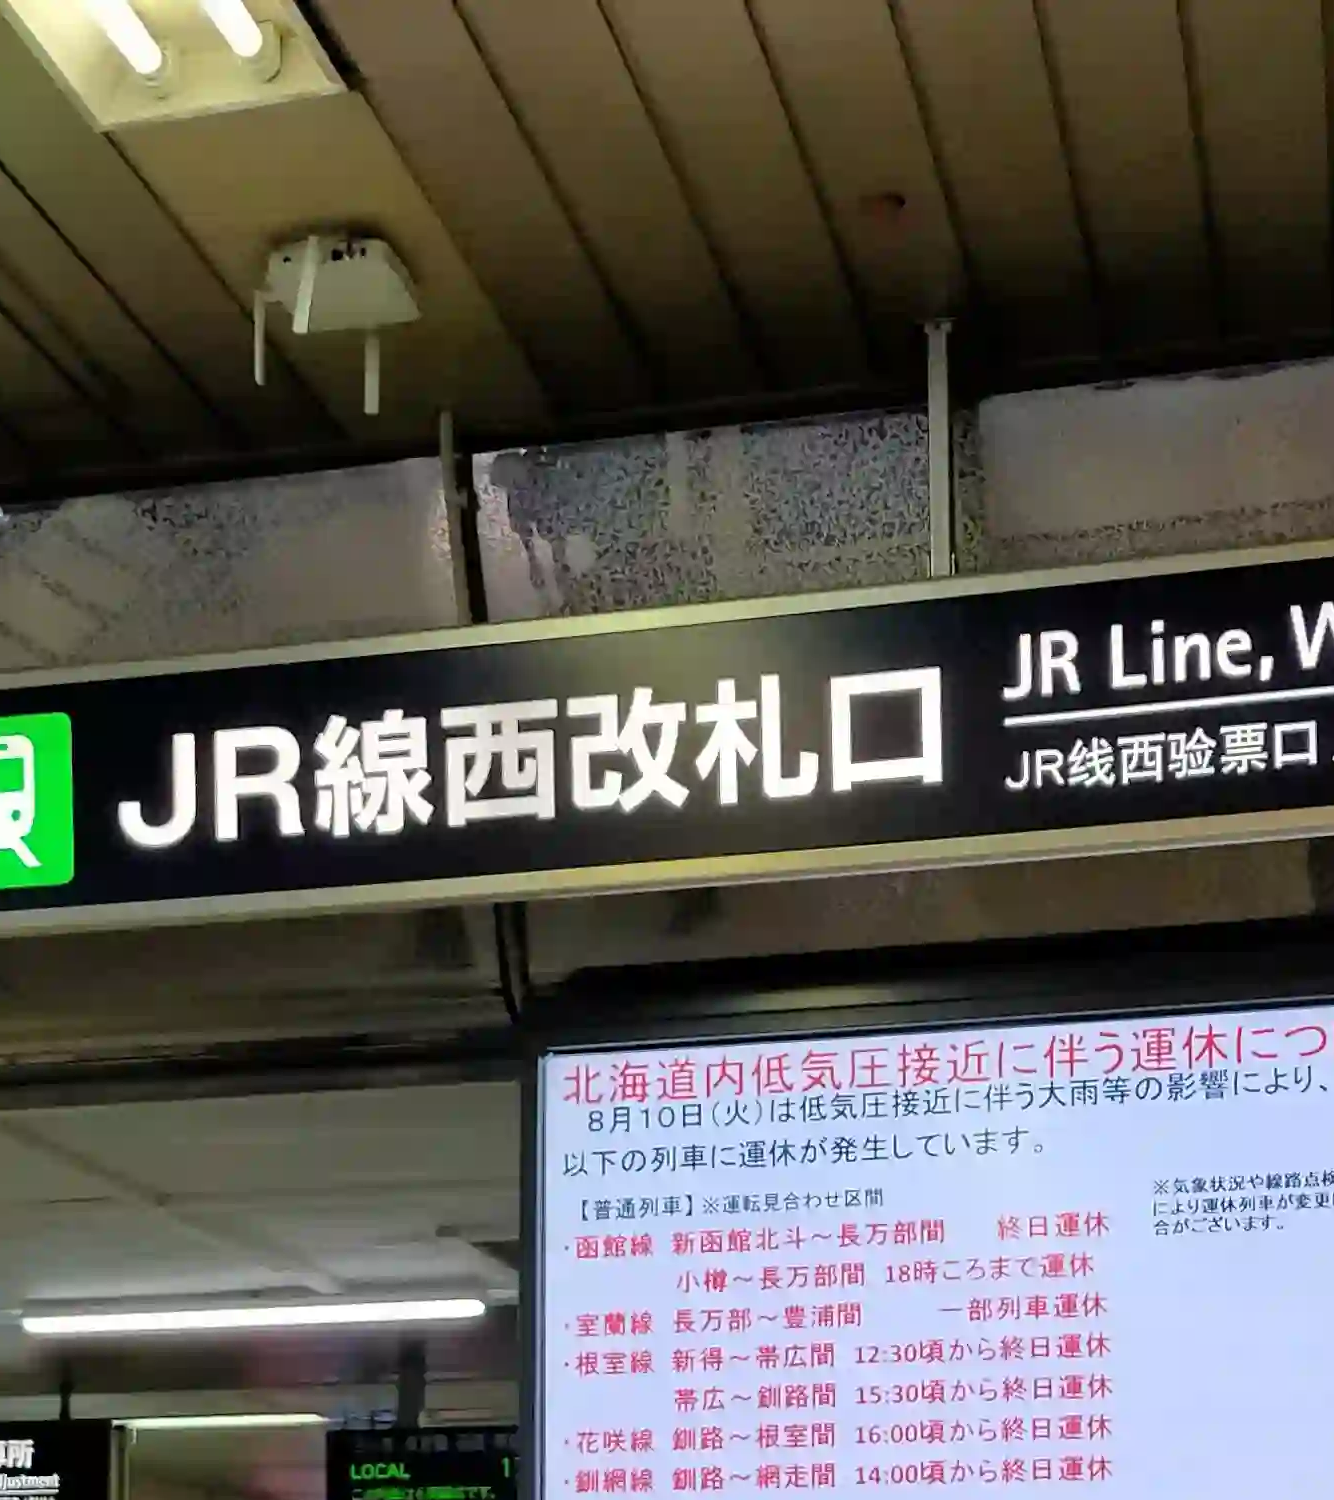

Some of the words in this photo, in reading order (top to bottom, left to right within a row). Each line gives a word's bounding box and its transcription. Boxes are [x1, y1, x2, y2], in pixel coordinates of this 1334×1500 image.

[1003, 630, 1078, 702] JR
[1109, 616, 1274, 690] Line,
[118, 665, 944, 851] JR線西改札口
[1003, 722, 1320, 791] JR线西验票口
[563, 1127, 1046, 1177] 以下の列車に運休が発生しています。
[579, 1187, 884, 1222] 【普通列車】※運転見合わせ区間
[997, 1211, 1110, 1240] 終日運休
[1154, 1214, 1285, 1237] 合がございます。
[884, 1251, 1094, 1284] 18時ころまで運休
[937, 1292, 1108, 1322] 一部列車運休
[854, 1332, 1111, 1365] 12:30頃から終日運休
[854, 1373, 1113, 1405] 15:30頃から終日運休
[854, 1414, 1112, 1446] 16:00頃から終日運休
[349, 1461, 412, 1481] LOCAL
[854, 1455, 1113, 1486] 14:00頃から終日運休
